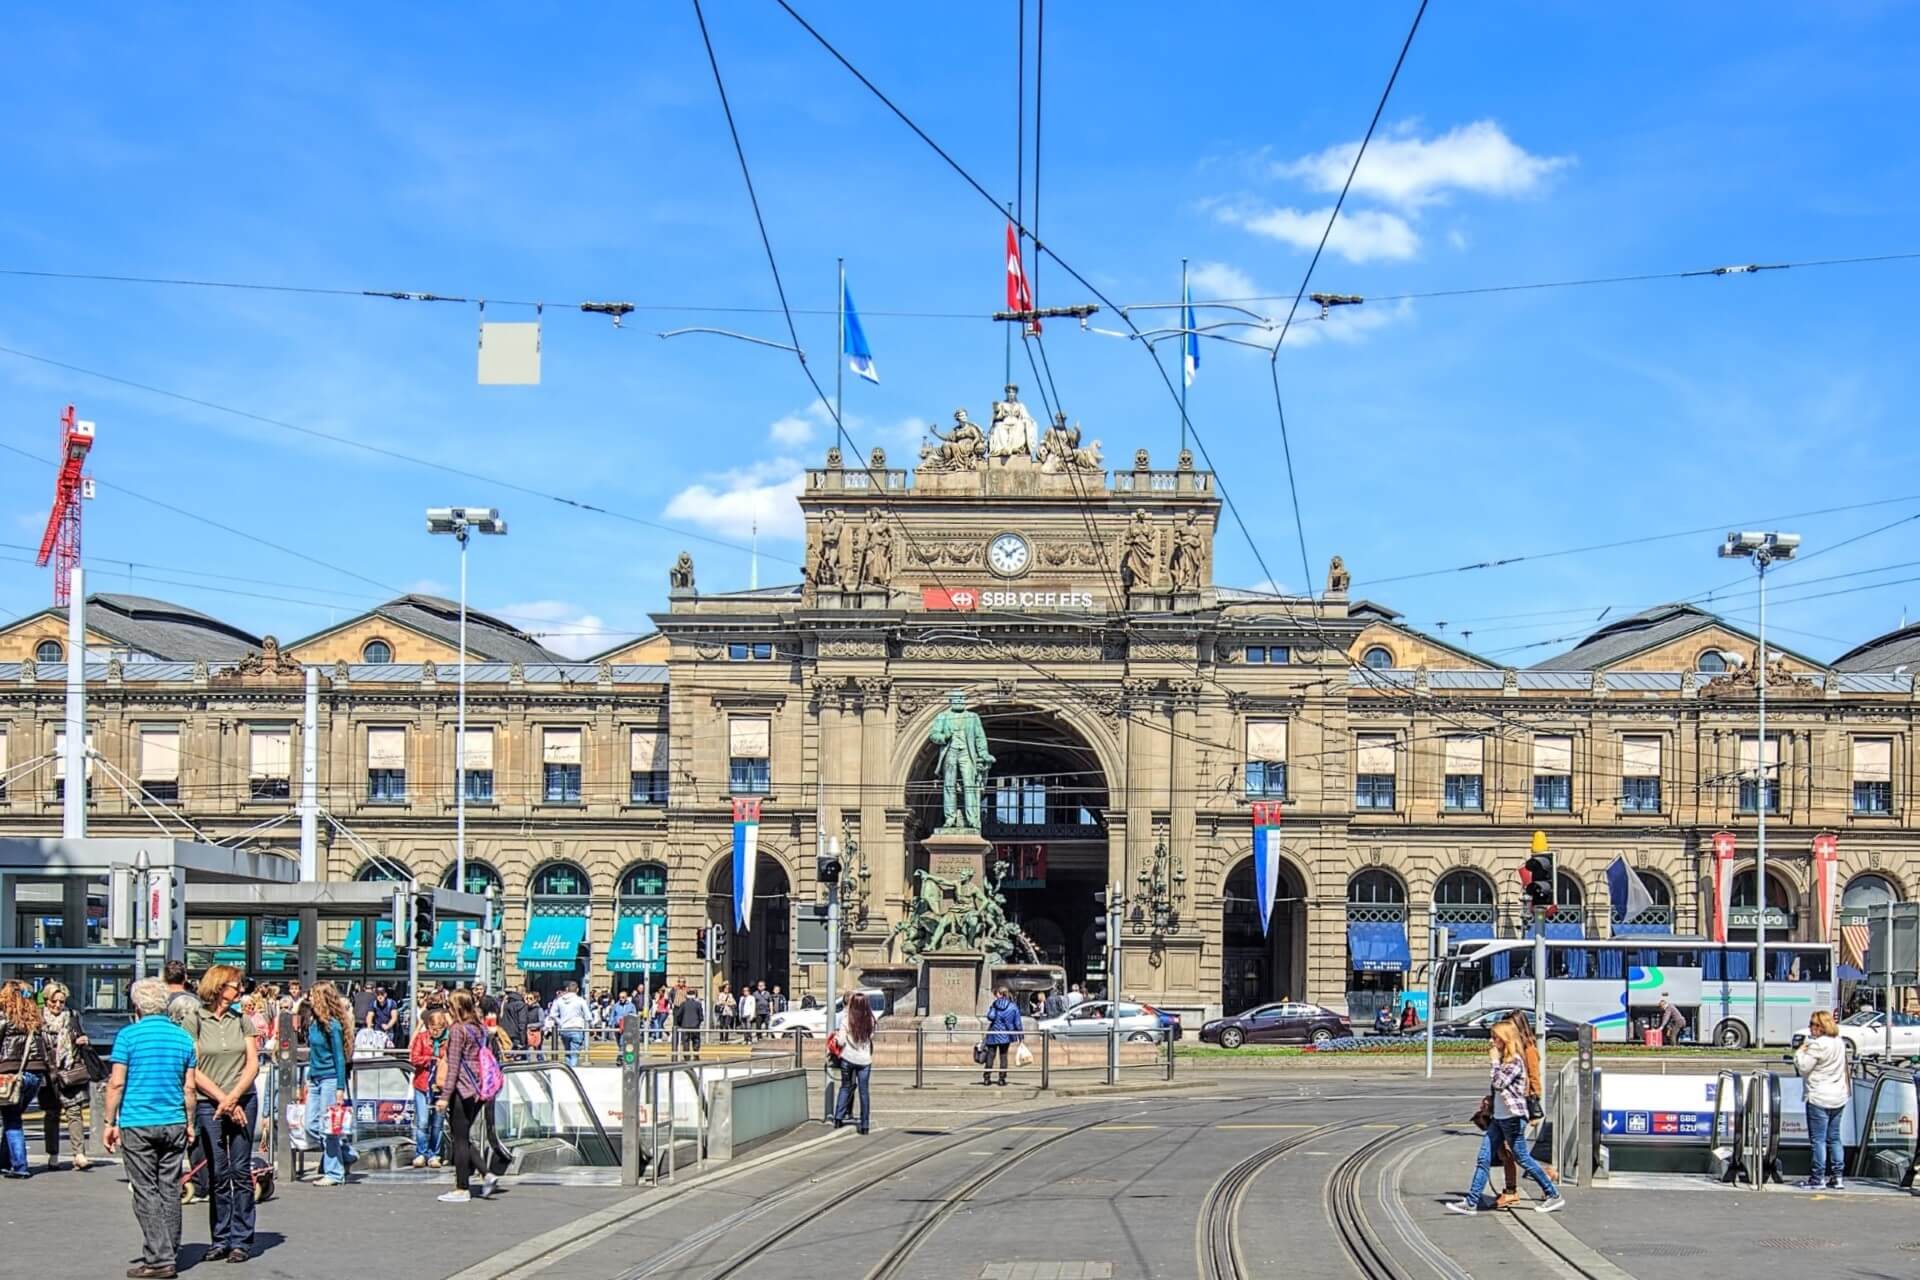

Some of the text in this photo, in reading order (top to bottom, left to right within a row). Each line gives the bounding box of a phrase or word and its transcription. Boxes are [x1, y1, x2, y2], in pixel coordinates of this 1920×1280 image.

[982, 591, 1017, 606] SBB
[1060, 592, 1093, 607] FFS
[1734, 915, 1749, 925] DA
[523, 960, 569, 969] PHARMACY
[614, 961, 657, 970] APOTHEE
